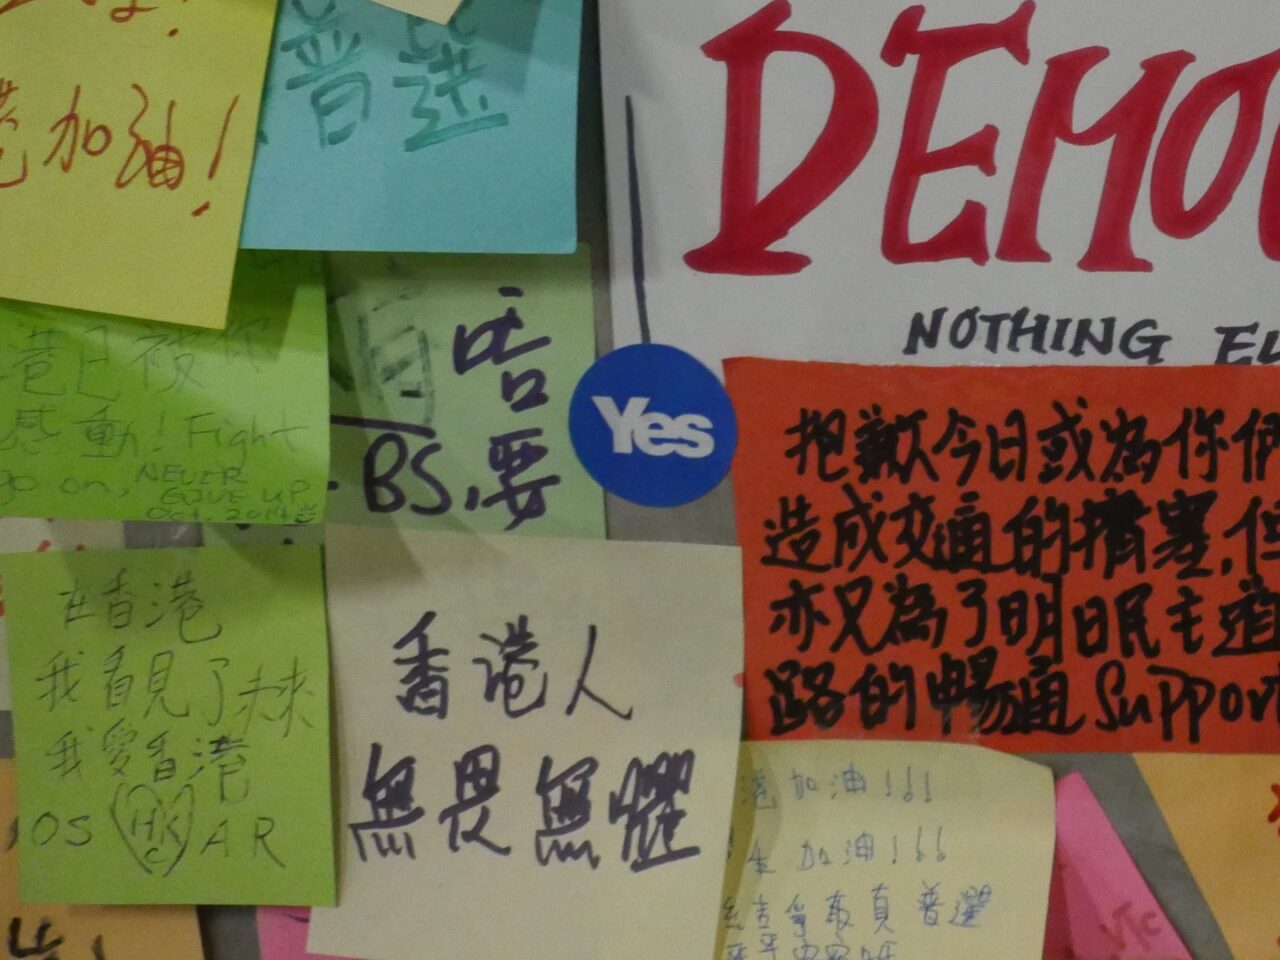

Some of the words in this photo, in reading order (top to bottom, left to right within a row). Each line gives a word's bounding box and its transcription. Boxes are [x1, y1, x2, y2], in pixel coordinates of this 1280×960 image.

[902, 304, 1174, 366] NOTHING
[591, 395, 715, 459] Yes
[392, 610, 635, 721] 香港人
